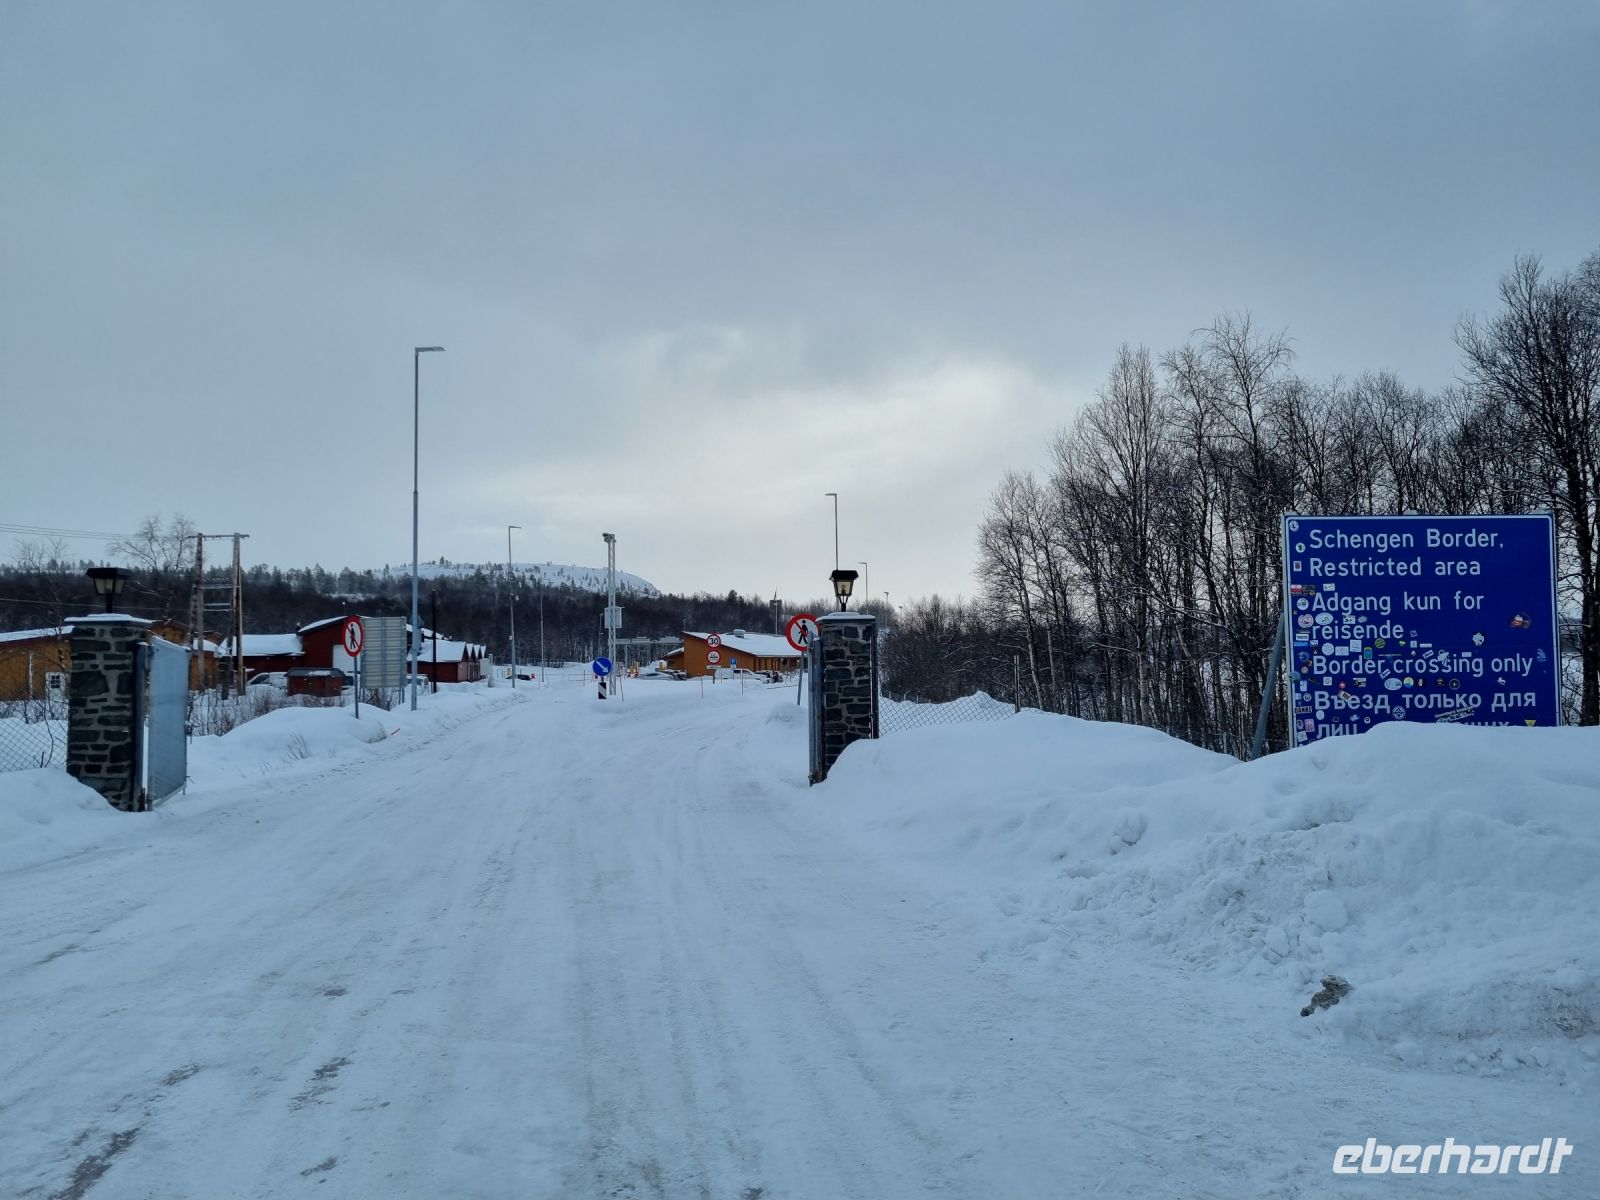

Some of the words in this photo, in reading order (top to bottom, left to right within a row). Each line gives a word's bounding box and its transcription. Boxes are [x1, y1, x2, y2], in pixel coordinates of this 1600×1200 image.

[1309, 528, 1414, 552] Schengen
[1427, 528, 1504, 549] Border,
[1310, 557, 1422, 577] Restricted
[1435, 560, 1481, 575] area
[1312, 592, 1391, 615] Adgang
[1404, 591, 1441, 610] kun
[1454, 590, 1485, 610] for
[1312, 620, 1404, 640] reisende
[1313, 655, 1385, 675] Border
[1393, 654, 1484, 677] crossing
[1491, 653, 1534, 677] only
[1315, 691, 1391, 714] Въезд
[1402, 692, 1482, 709] только
[1491, 691, 1537, 713] для
